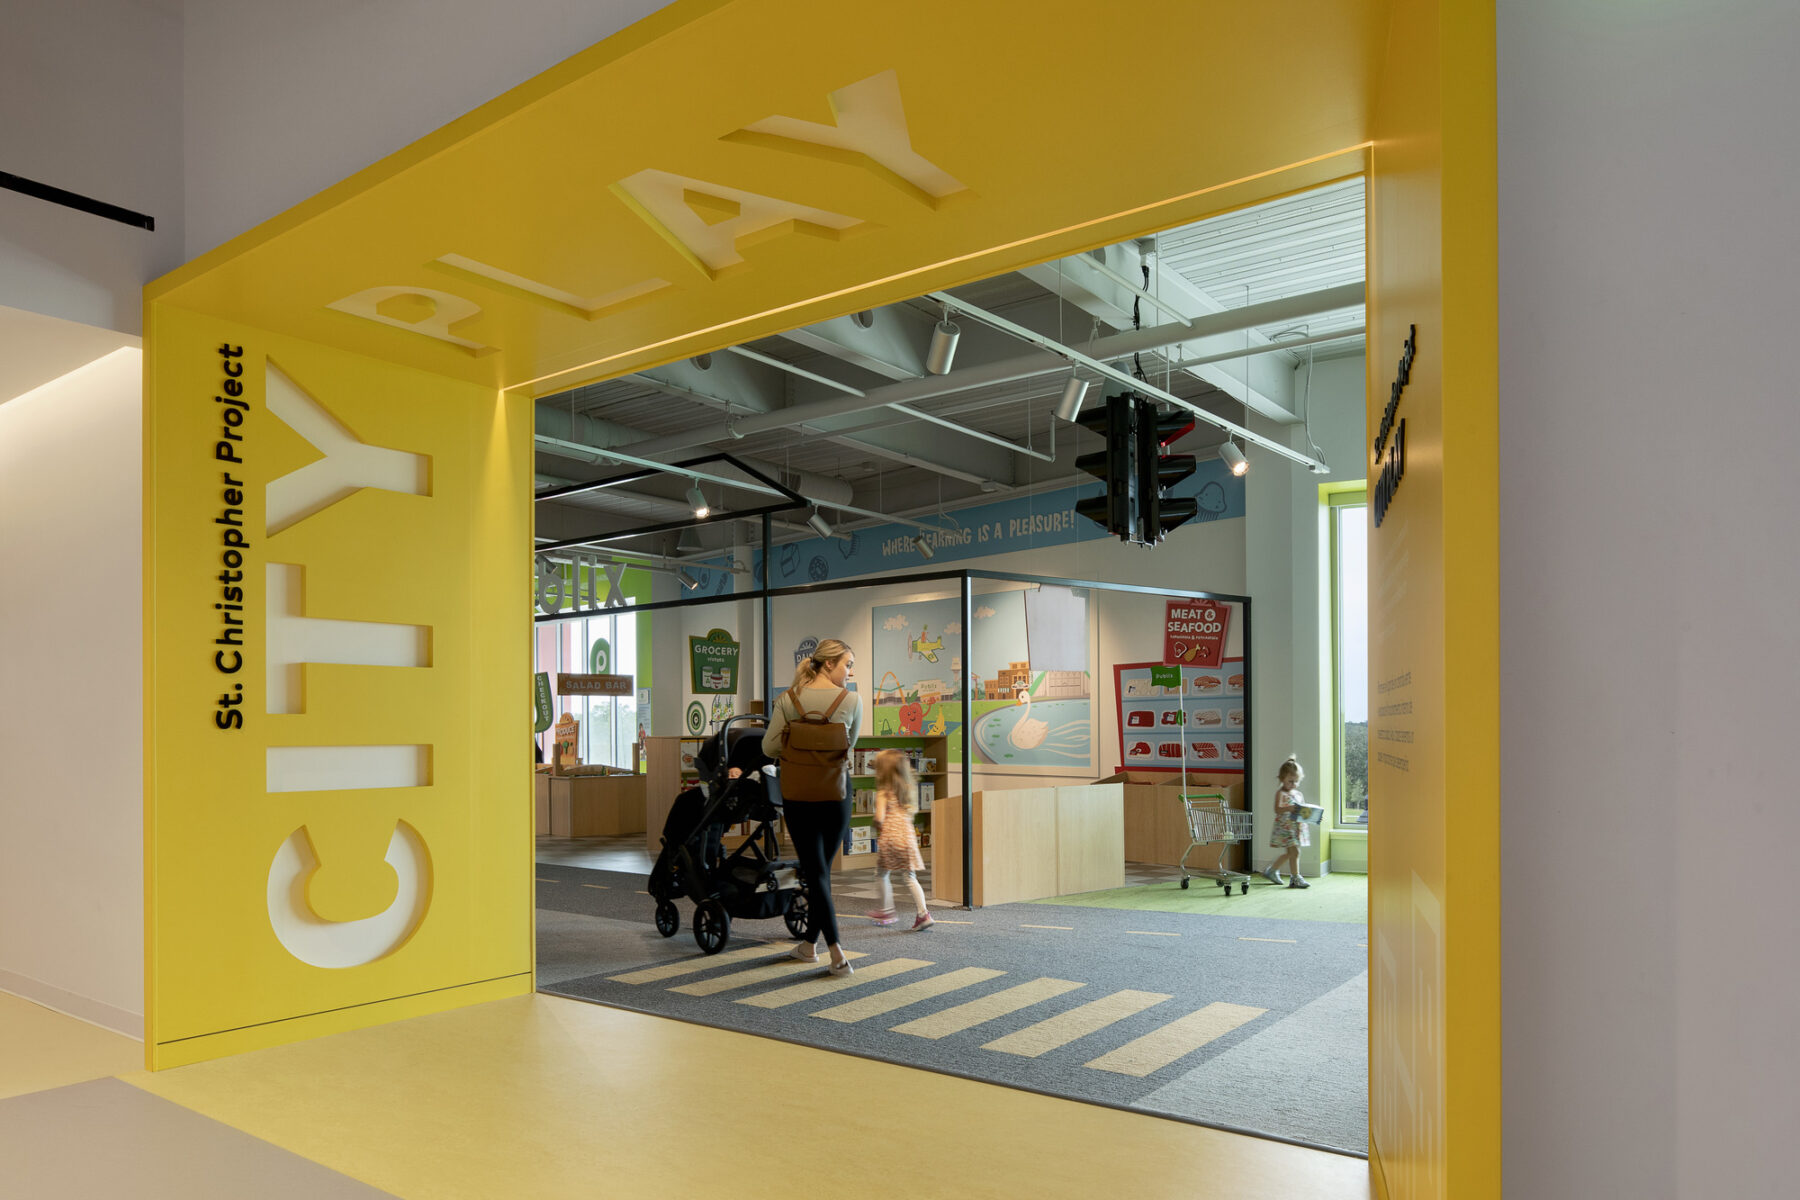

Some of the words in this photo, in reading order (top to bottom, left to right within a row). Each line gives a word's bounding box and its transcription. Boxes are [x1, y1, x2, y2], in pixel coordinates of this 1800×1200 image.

[322, 68, 971, 358] PLAY
[215, 343, 249, 464] Project
[882, 535, 916, 556] WHERE
[922, 527, 972, 549] EARNING
[977, 524, 990, 543] IS
[994, 522, 1002, 539] A
[1009, 509, 1074, 538] PLEASURE!
[215, 472, 249, 675] Christopher
[1168, 622, 1221, 633] SEAFOOD
[1171, 608, 1203, 619] MEAT
[265, 353, 434, 969] CITY
[694, 645, 738, 656] GROCERY
[215, 683, 243, 730] St.
[536, 675, 549, 721] CHECKOUT
[566, 681, 601, 689] SALAD
[605, 681, 627, 689] BAR
